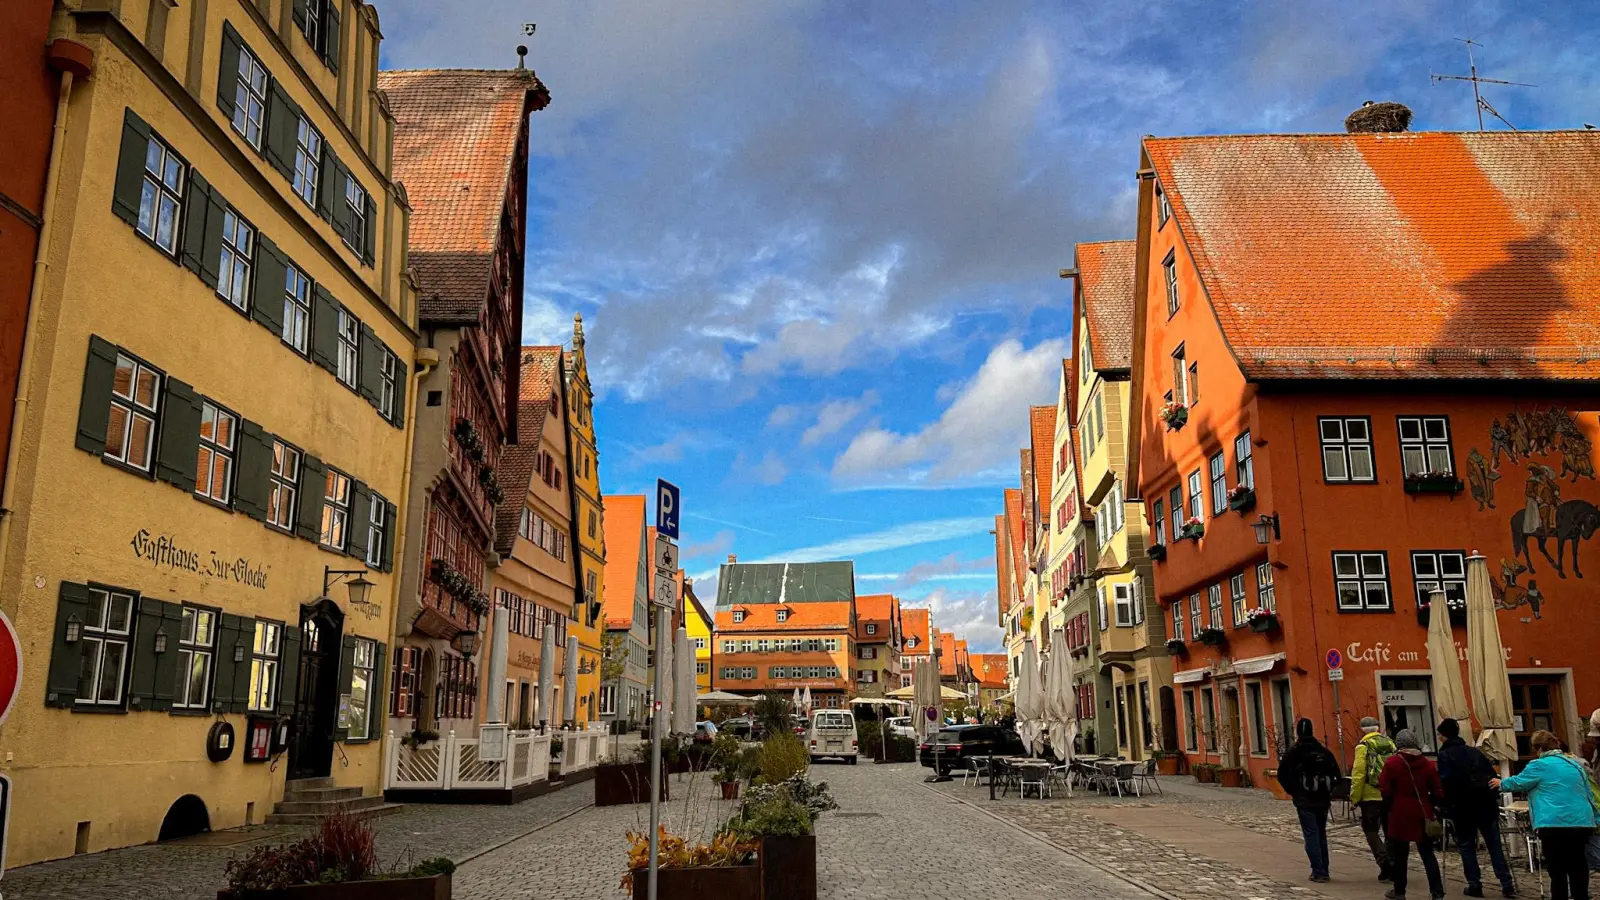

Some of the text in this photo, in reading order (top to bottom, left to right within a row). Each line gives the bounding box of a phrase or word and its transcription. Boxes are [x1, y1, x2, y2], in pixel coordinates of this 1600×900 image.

[660, 486, 673, 527] P
[1346, 642, 1391, 666] Café
[1398, 651, 1419, 661] am
